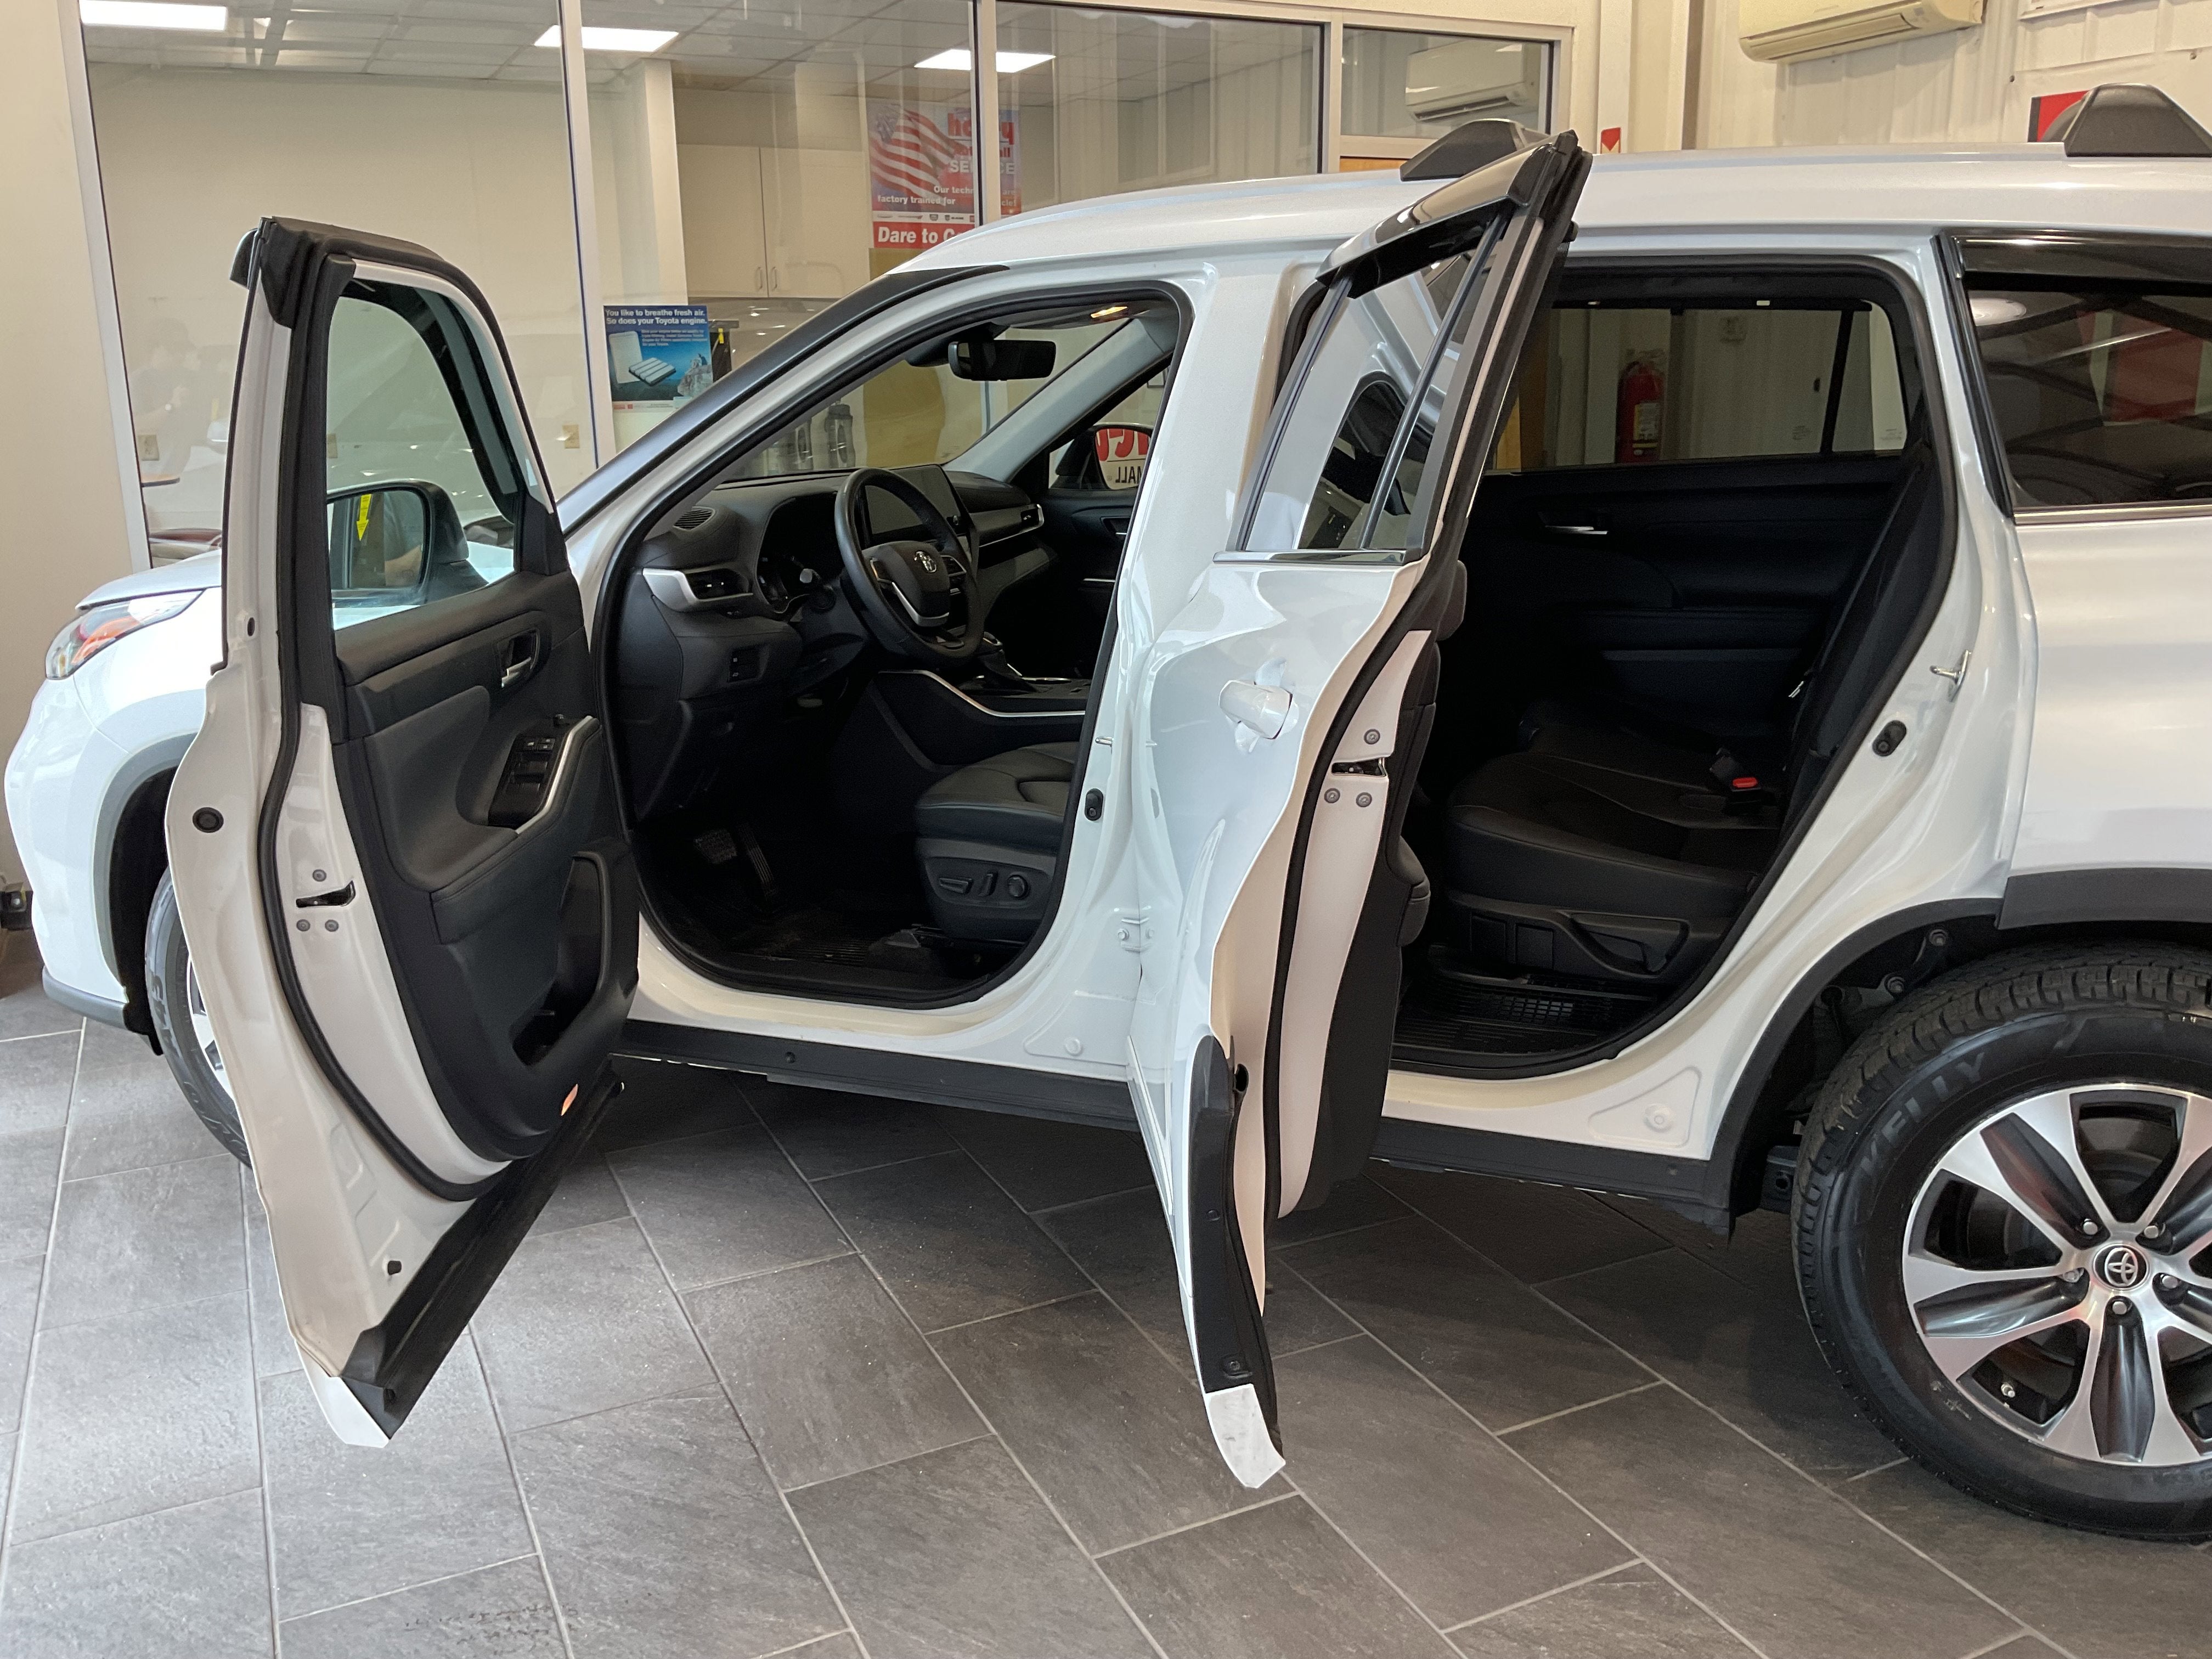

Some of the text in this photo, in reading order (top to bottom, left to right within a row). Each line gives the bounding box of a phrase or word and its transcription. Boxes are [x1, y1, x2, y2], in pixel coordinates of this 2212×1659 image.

[878, 195, 908, 204] factory
[911, 196, 940, 204] trained
[943, 196, 956, 205] for
[878, 227, 917, 243] Dare
[922, 228, 939, 244] to
[655, 317, 679, 325] Toyota
